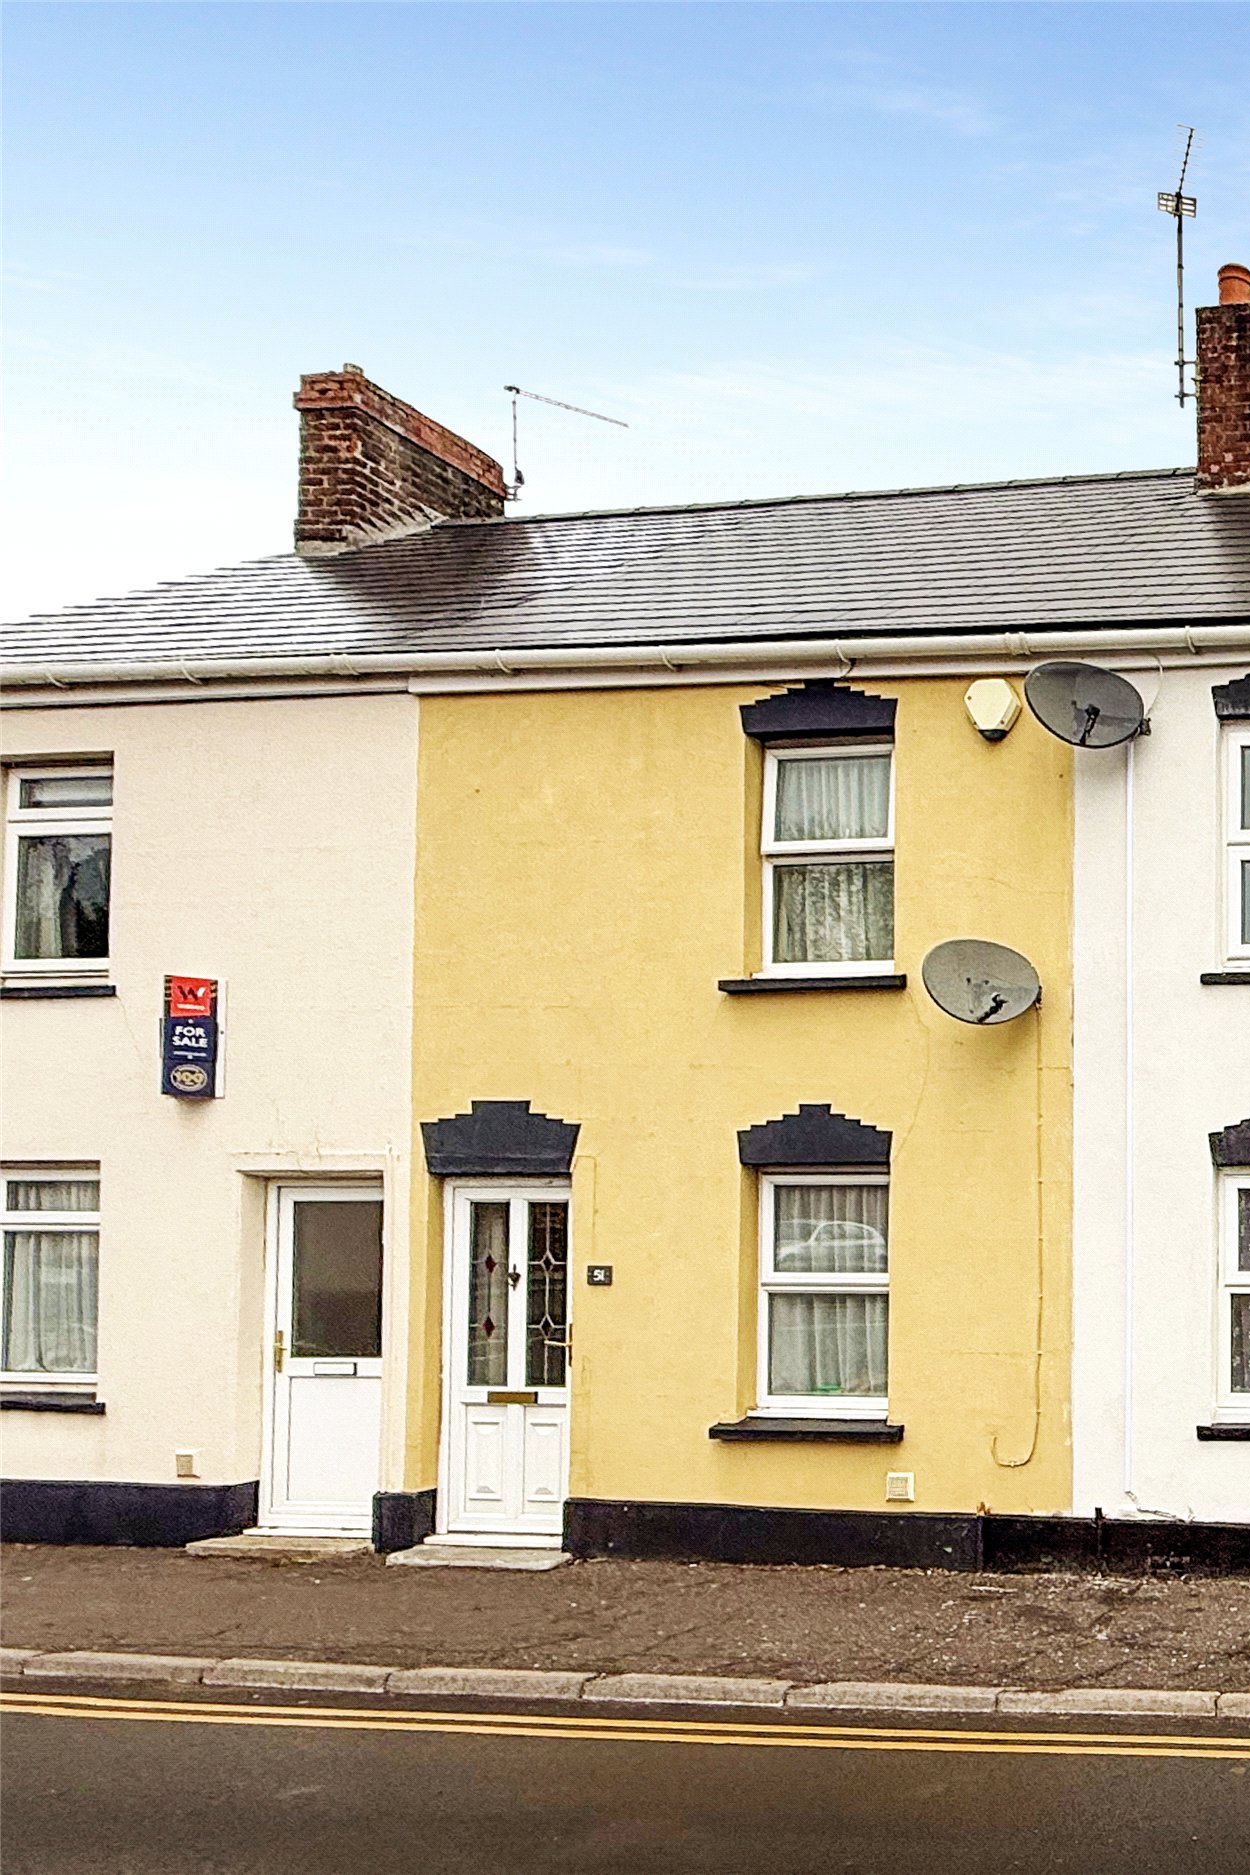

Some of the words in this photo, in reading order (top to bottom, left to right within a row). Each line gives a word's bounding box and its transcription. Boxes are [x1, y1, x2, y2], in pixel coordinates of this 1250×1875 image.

[175, 1025, 205, 1037] FOR
[172, 1036, 208, 1048] SALE
[593, 1269, 605, 1281] 51
